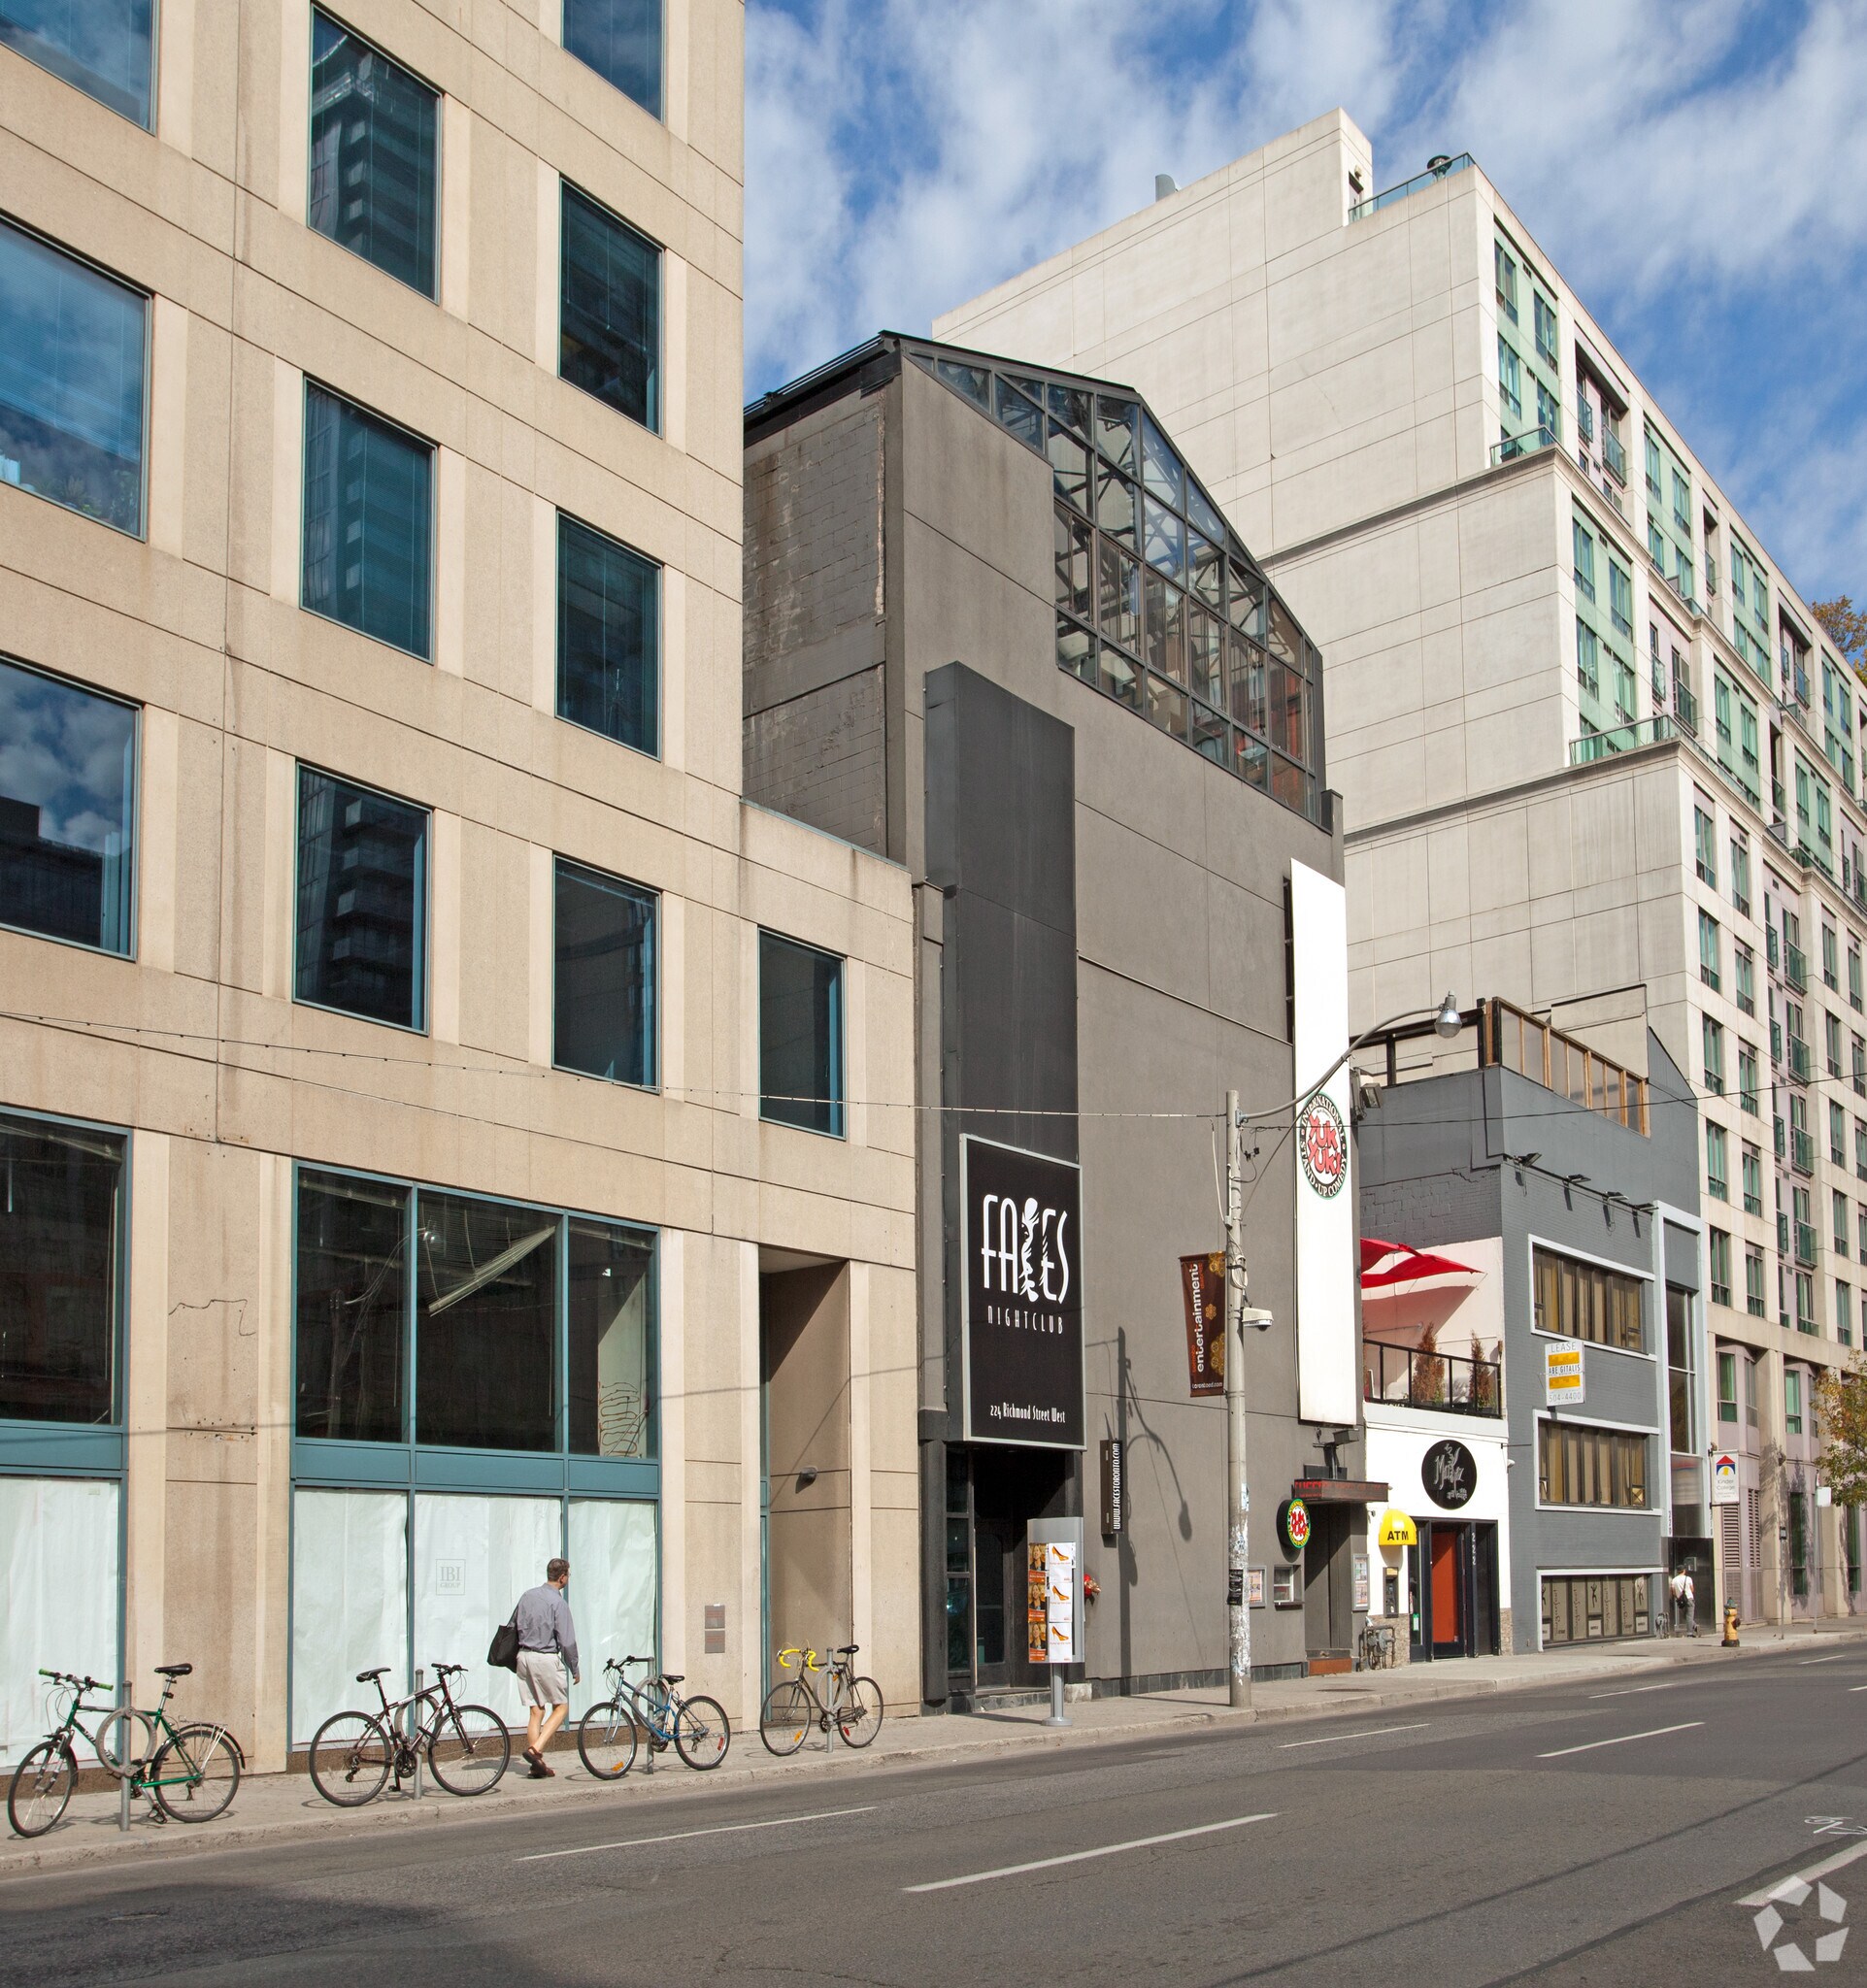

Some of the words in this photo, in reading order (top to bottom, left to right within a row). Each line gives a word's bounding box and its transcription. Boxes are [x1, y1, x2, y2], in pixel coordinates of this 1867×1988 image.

[981, 1193, 1070, 1305] FACES
[987, 1305, 1063, 1335] NIGHTCLUB
[1189, 1263, 1204, 1373] entertainment
[1550, 1341, 1577, 1353] LEASE
[1549, 1366, 1558, 1375] ABE
[990, 1405, 1002, 1420] 224
[1003, 1402, 1031, 1420] Richmond
[1032, 1405, 1050, 1422] Street
[1050, 1407, 1066, 1423] West
[1112, 1442, 1121, 1530] WWW.FACESTORONTO.COM
[1387, 1531, 1409, 1541] ATM
[440, 1566, 462, 1581] IBI
